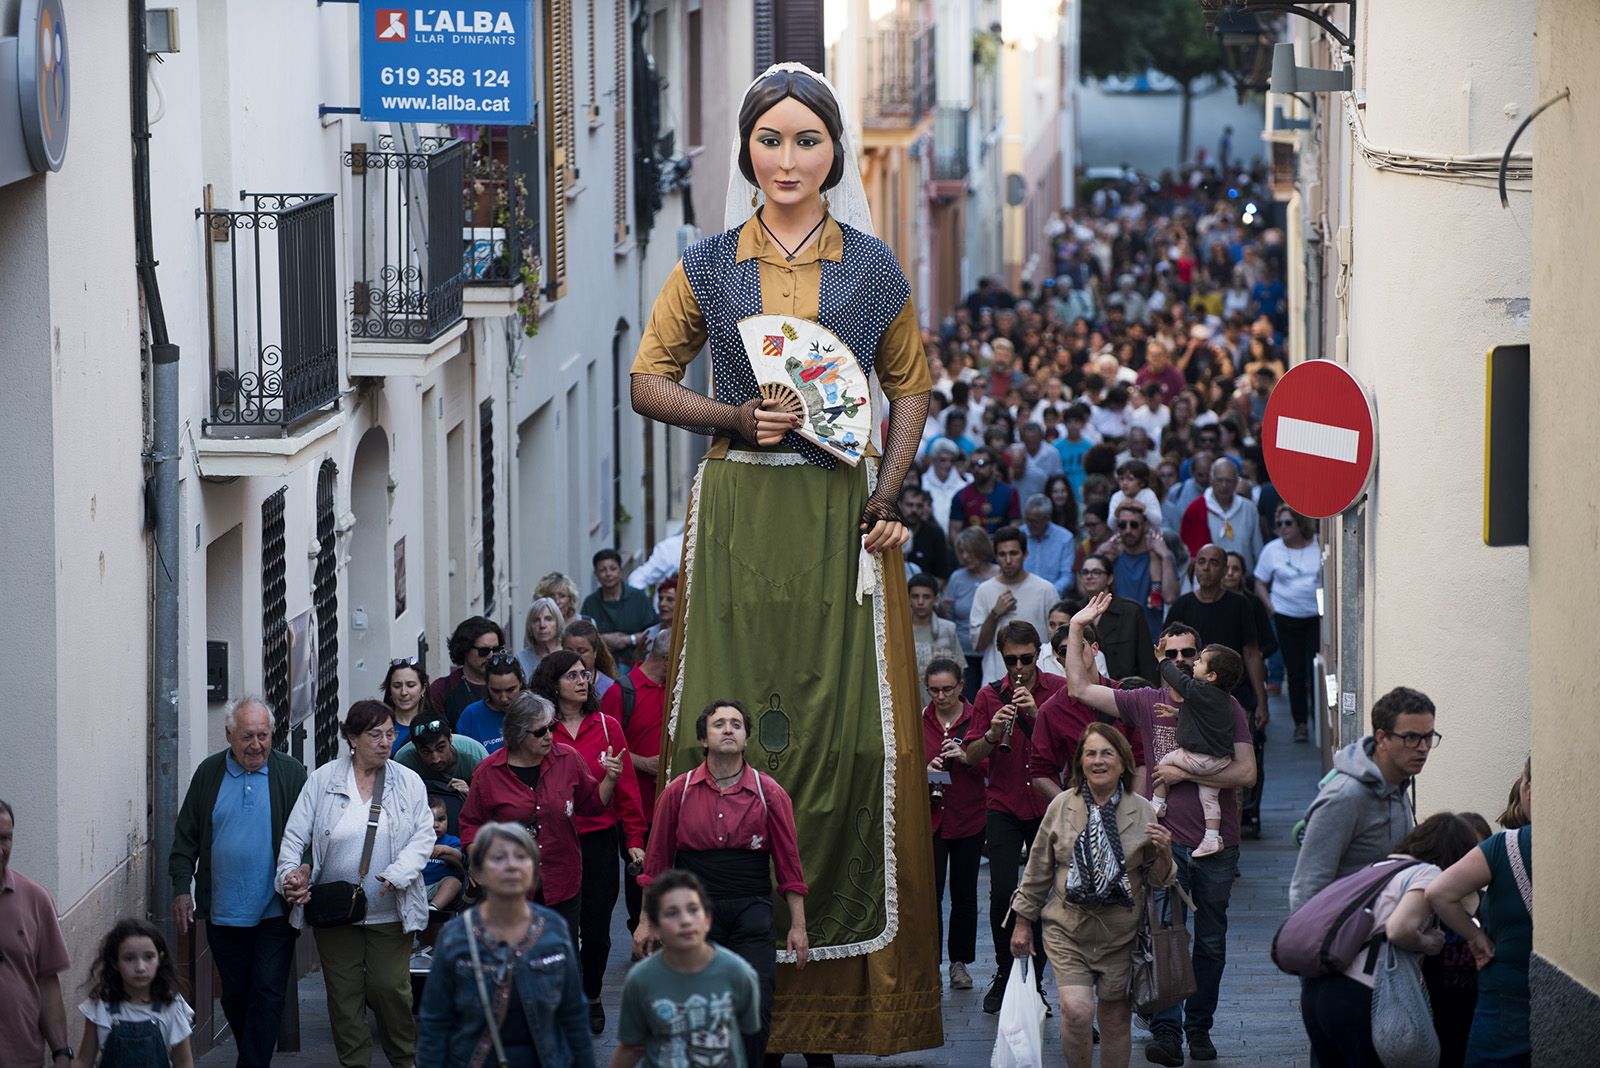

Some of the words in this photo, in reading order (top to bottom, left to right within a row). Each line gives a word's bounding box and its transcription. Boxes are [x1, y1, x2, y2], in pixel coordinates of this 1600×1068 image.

[415, 34, 444, 43] LLAR
[452, 34, 516, 46] D'INFANTS
[381, 67, 420, 86] 619
[426, 68, 465, 87] 358
[472, 69, 510, 88] 124
[381, 94, 510, 112] www.lalba.cat
